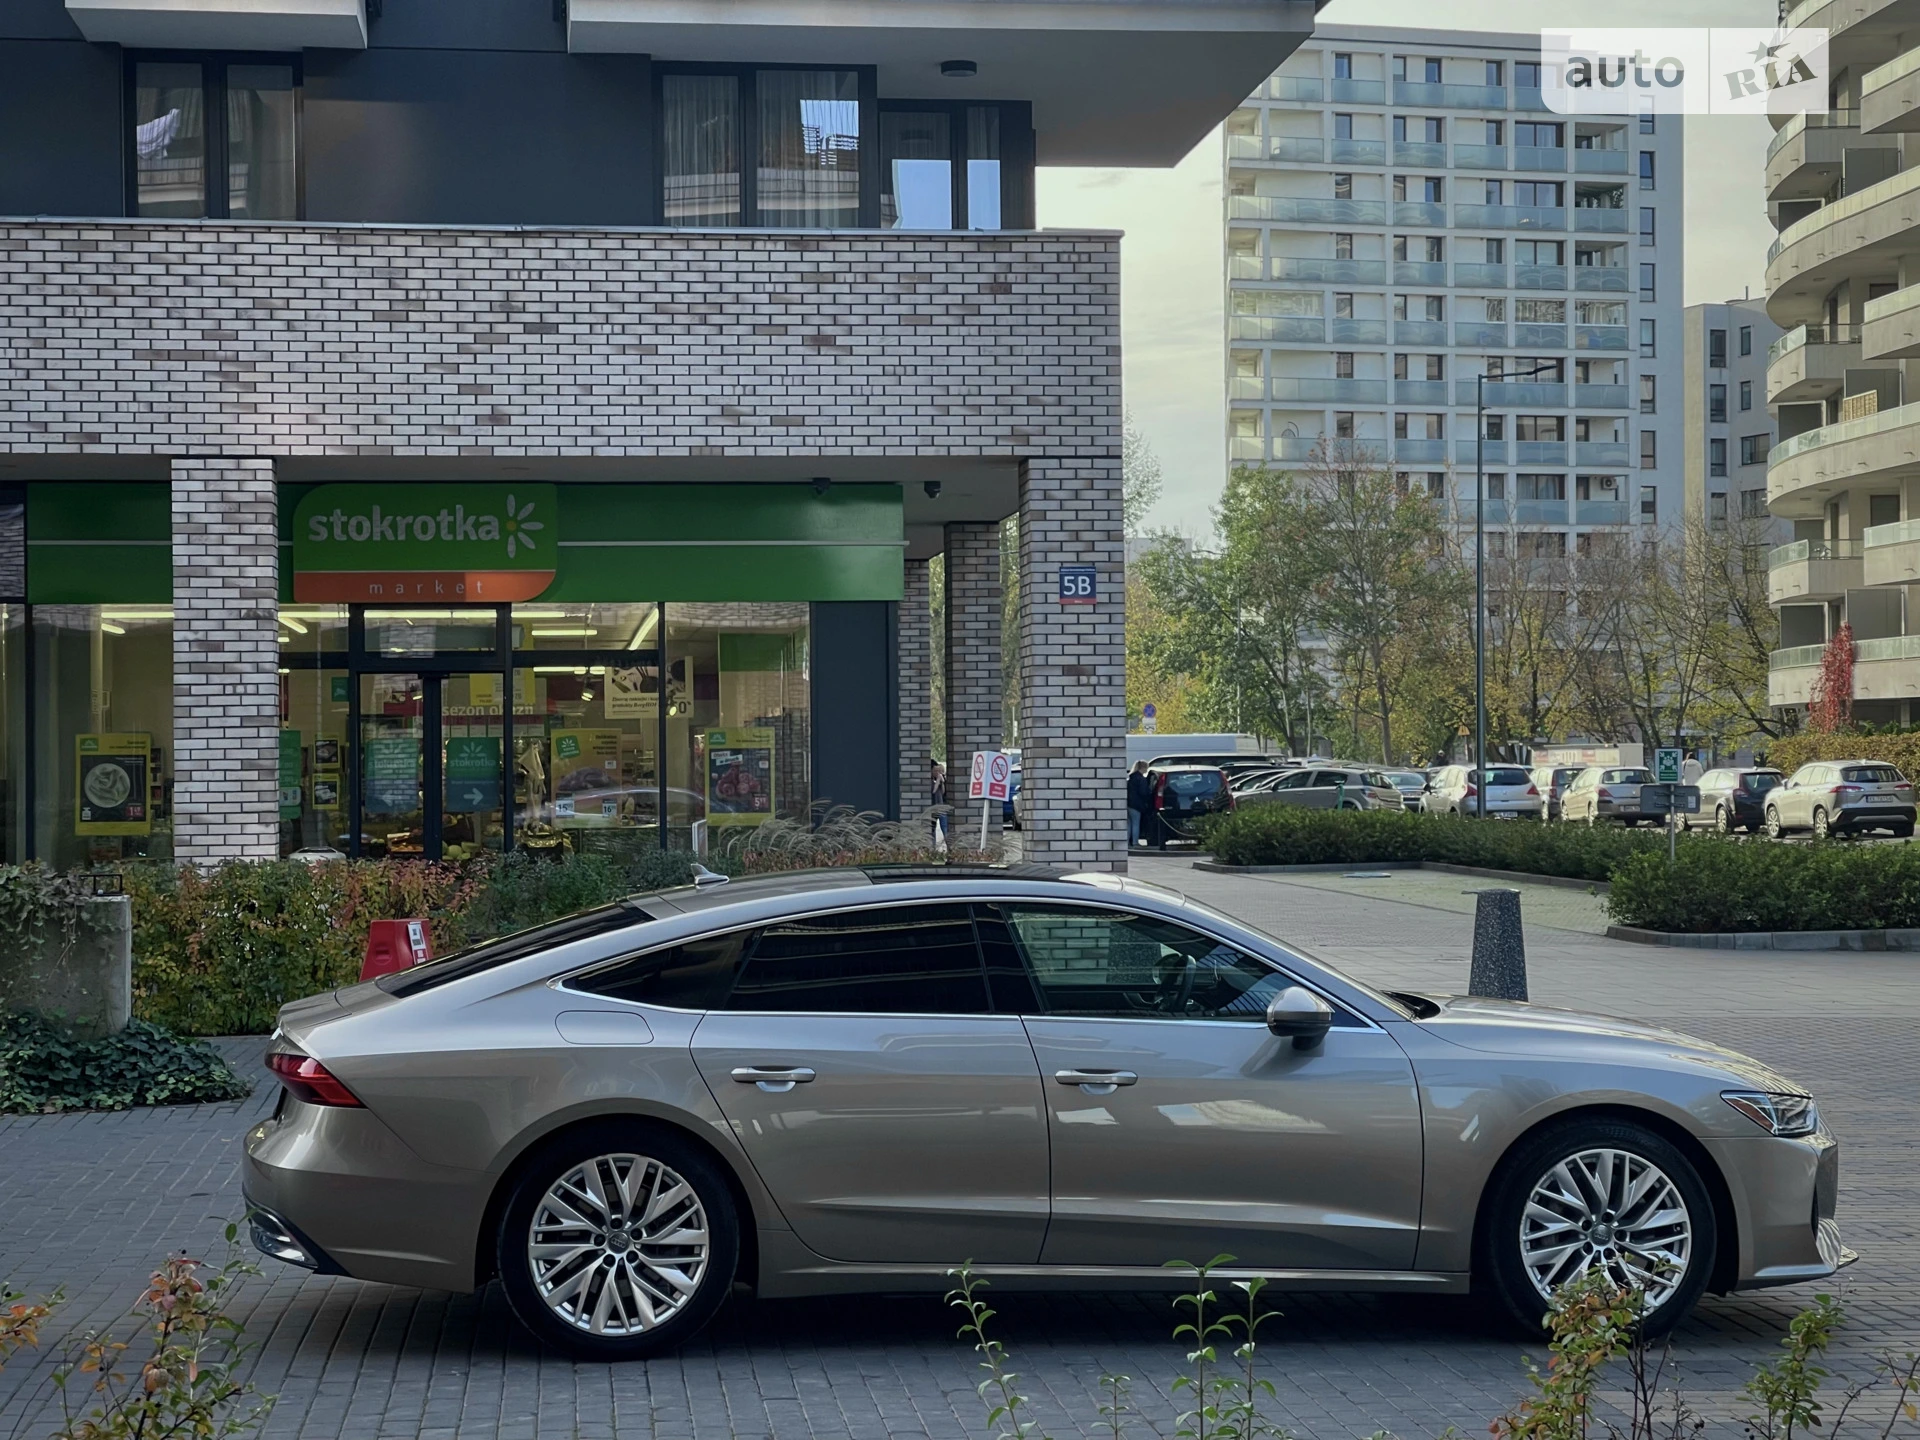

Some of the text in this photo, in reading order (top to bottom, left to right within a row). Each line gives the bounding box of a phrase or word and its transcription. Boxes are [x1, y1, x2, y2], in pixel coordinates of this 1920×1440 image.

[308, 504, 500, 542] stokrotka
[369, 580, 483, 595] market
[1063, 575, 1092, 596] 5B
[442, 705, 485, 716] sezon
[449, 757, 496, 768] stokrotka
